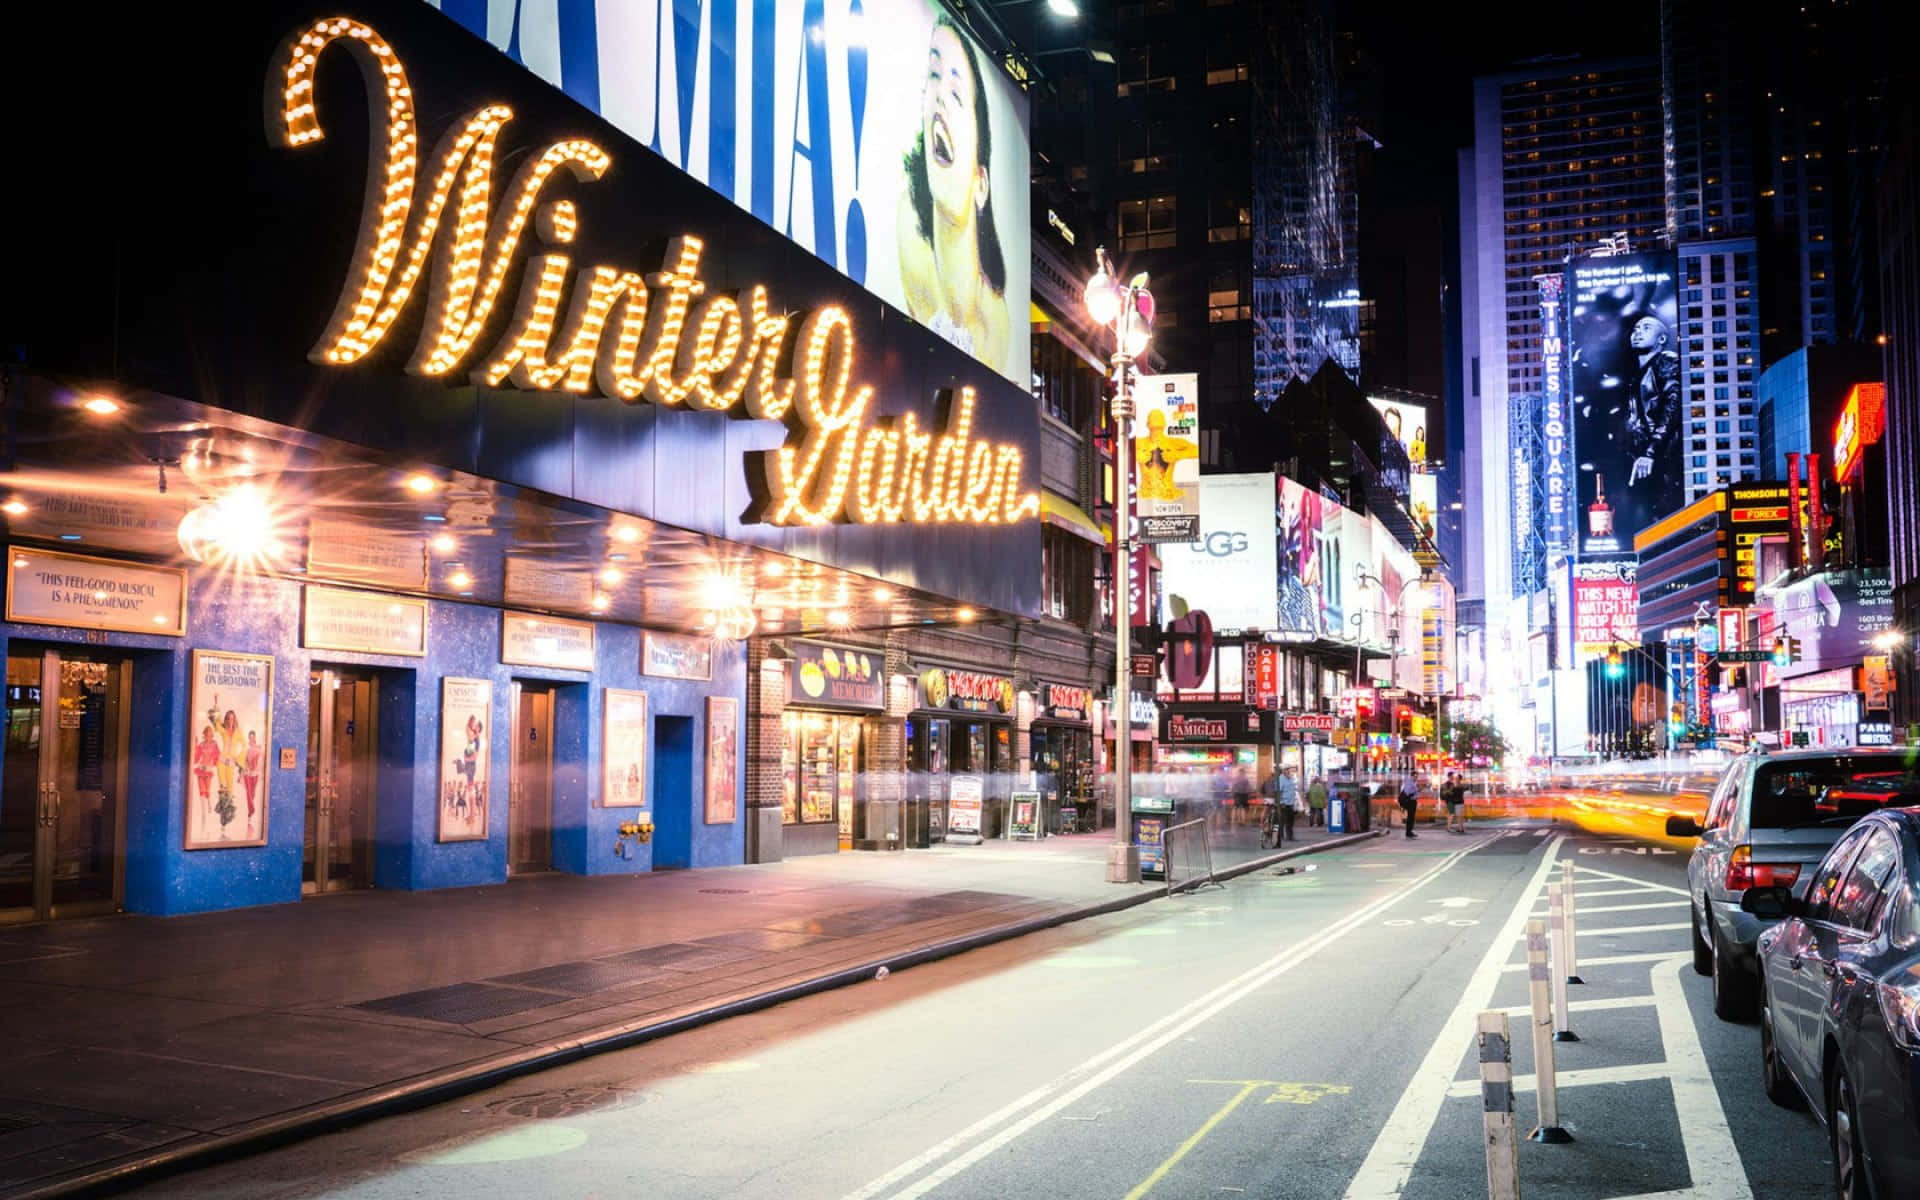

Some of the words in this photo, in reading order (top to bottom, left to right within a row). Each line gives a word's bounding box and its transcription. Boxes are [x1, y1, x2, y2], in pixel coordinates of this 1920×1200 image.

[282, 16, 798, 421] Winter
[1541, 302, 1562, 391] TIMES
[774, 304, 1042, 524] Garden
[1546, 402, 1564, 513] SQUARE
[1733, 488, 1778, 500] THOMSON
[1747, 510, 1778, 518] FOREX
[1191, 531, 1249, 558] UGG
[64, 575, 117, 592] FEEL-GOOD
[118, 582, 156, 598] MUSICAL
[1577, 587, 1604, 601] THIS
[1605, 586, 1632, 601] NEW
[51, 589, 61, 602] IS
[63, 593, 71, 603] A
[1577, 601, 1618, 614] WATCH
[1577, 614, 1608, 627] DROP
[1577, 627, 1608, 641] YOUR
[1247, 643, 1257, 675] FOOT
[223, 663, 241, 675] BEST
[243, 665, 258, 677] TIME
[204, 674, 216, 686] ON
[831, 681, 879, 701] MEMORIES
[1286, 716, 1332, 728] FAMIGLIA
[1577, 847, 1677, 855] ONL
